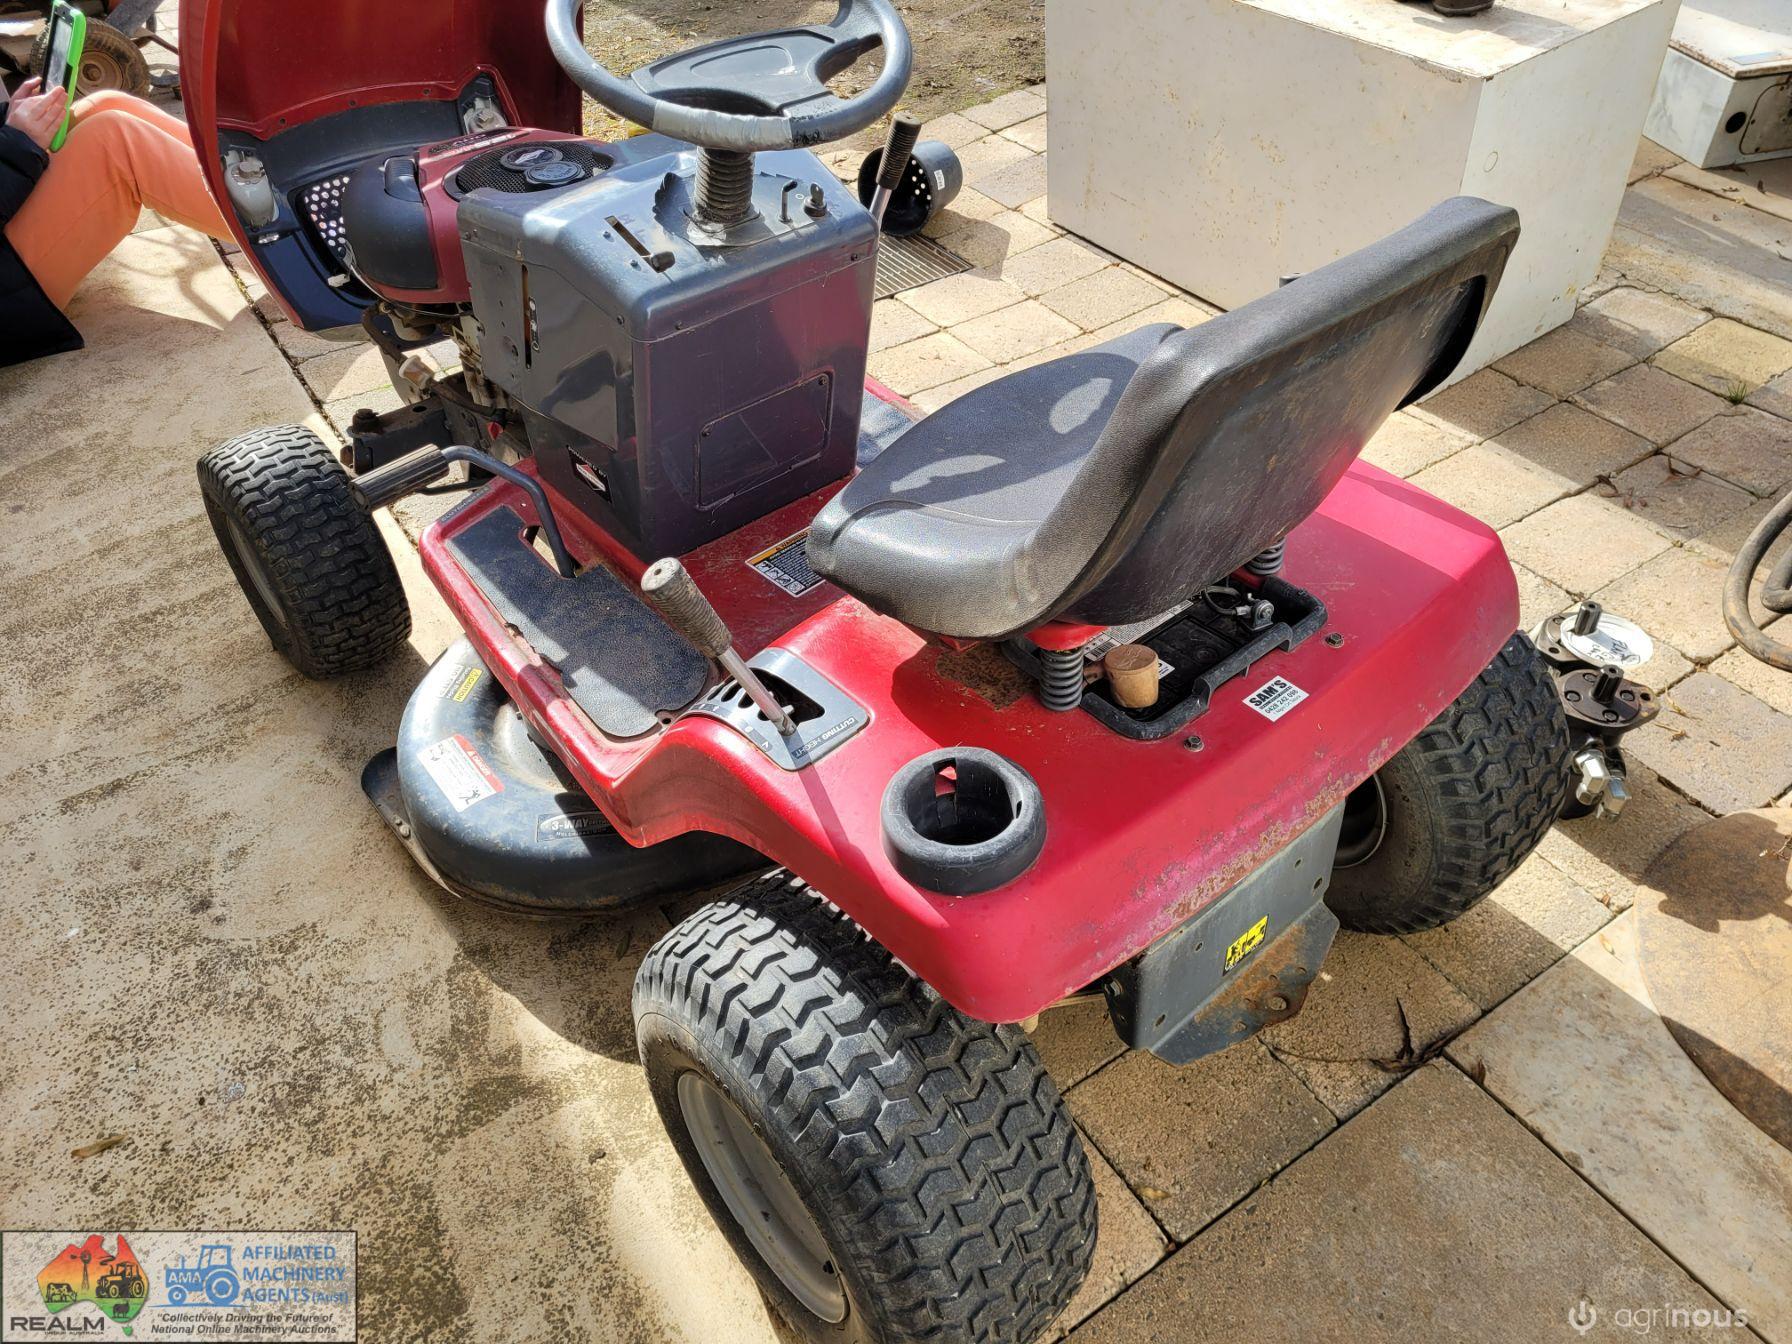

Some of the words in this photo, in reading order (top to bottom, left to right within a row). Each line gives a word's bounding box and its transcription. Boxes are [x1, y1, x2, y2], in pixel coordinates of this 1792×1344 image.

[1249, 680, 1287, 707] SAM'S
[822, 717, 855, 740] CUTTING
[795, 738, 822, 758] HEIGHT
[551, 817, 589, 831] 3-WAY
